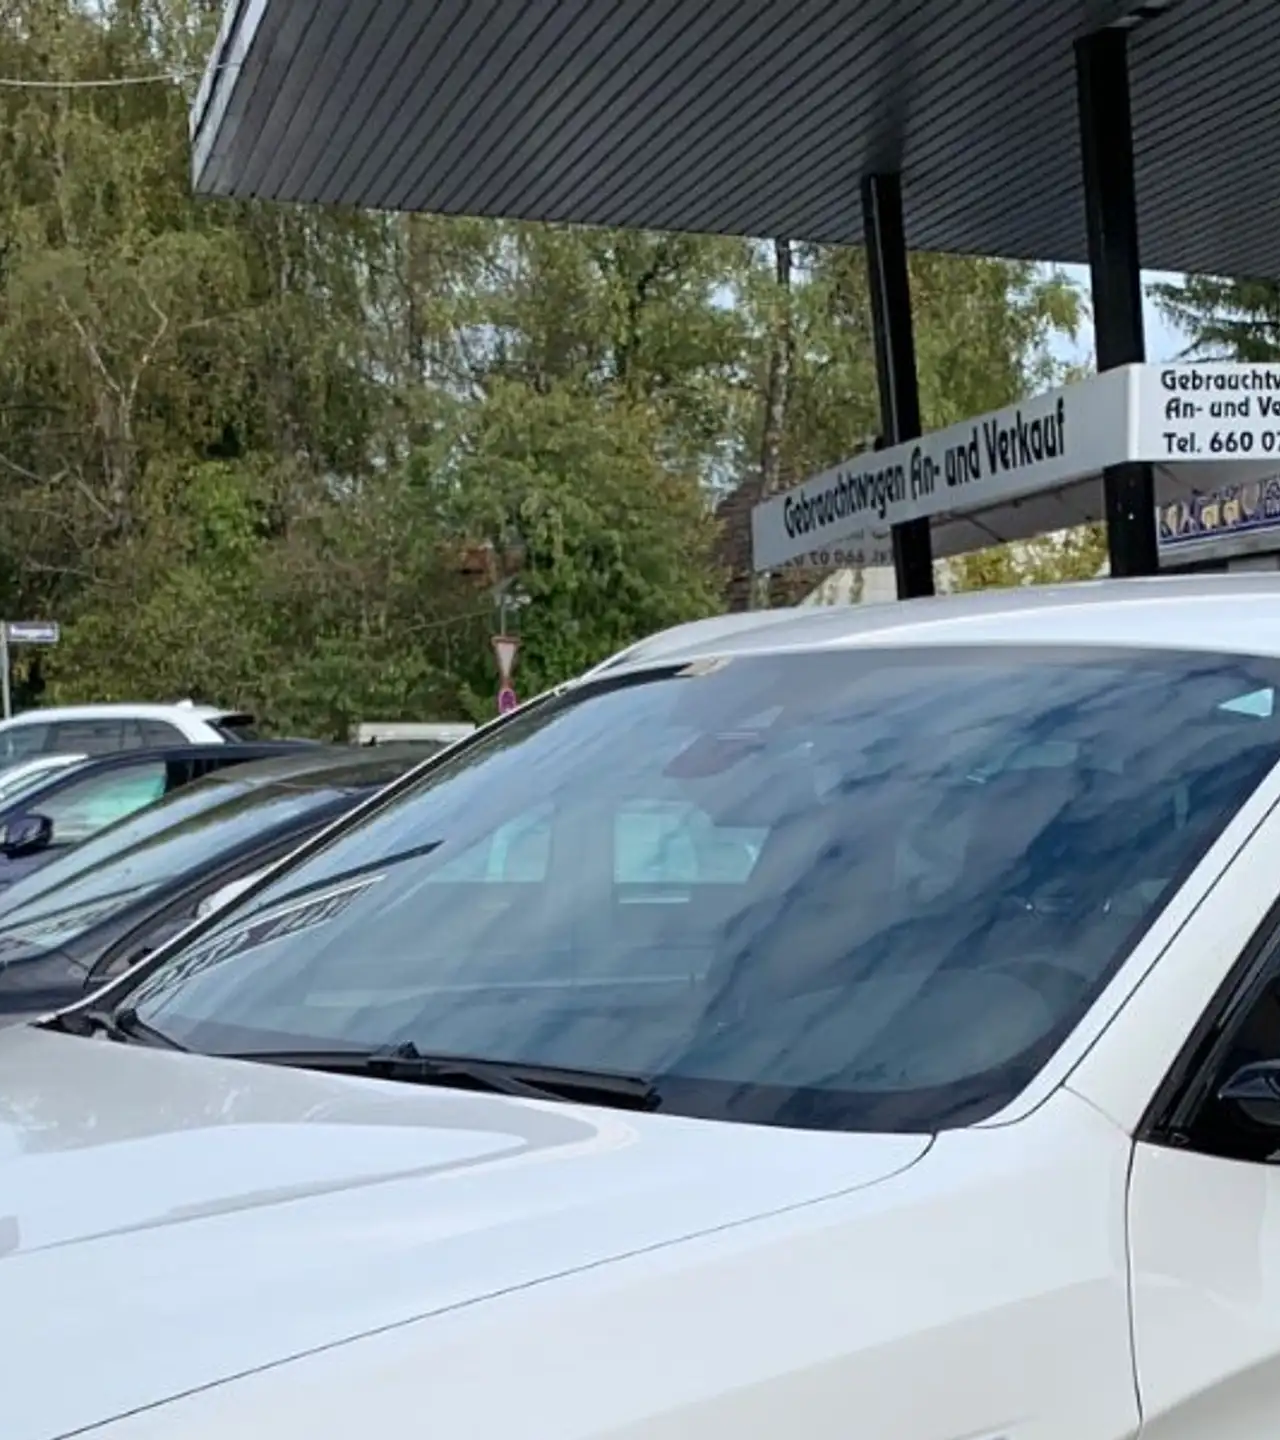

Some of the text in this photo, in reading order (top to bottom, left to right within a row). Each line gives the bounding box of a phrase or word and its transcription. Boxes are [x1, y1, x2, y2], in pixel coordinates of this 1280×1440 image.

[1165, 396, 1203, 420] An-
[1209, 396, 1250, 418] und
[1163, 432, 1202, 454] Tel.
[1209, 431, 1254, 454] 660
[783, 397, 1066, 540] Gebrauchtwagen An- und Verkauf
